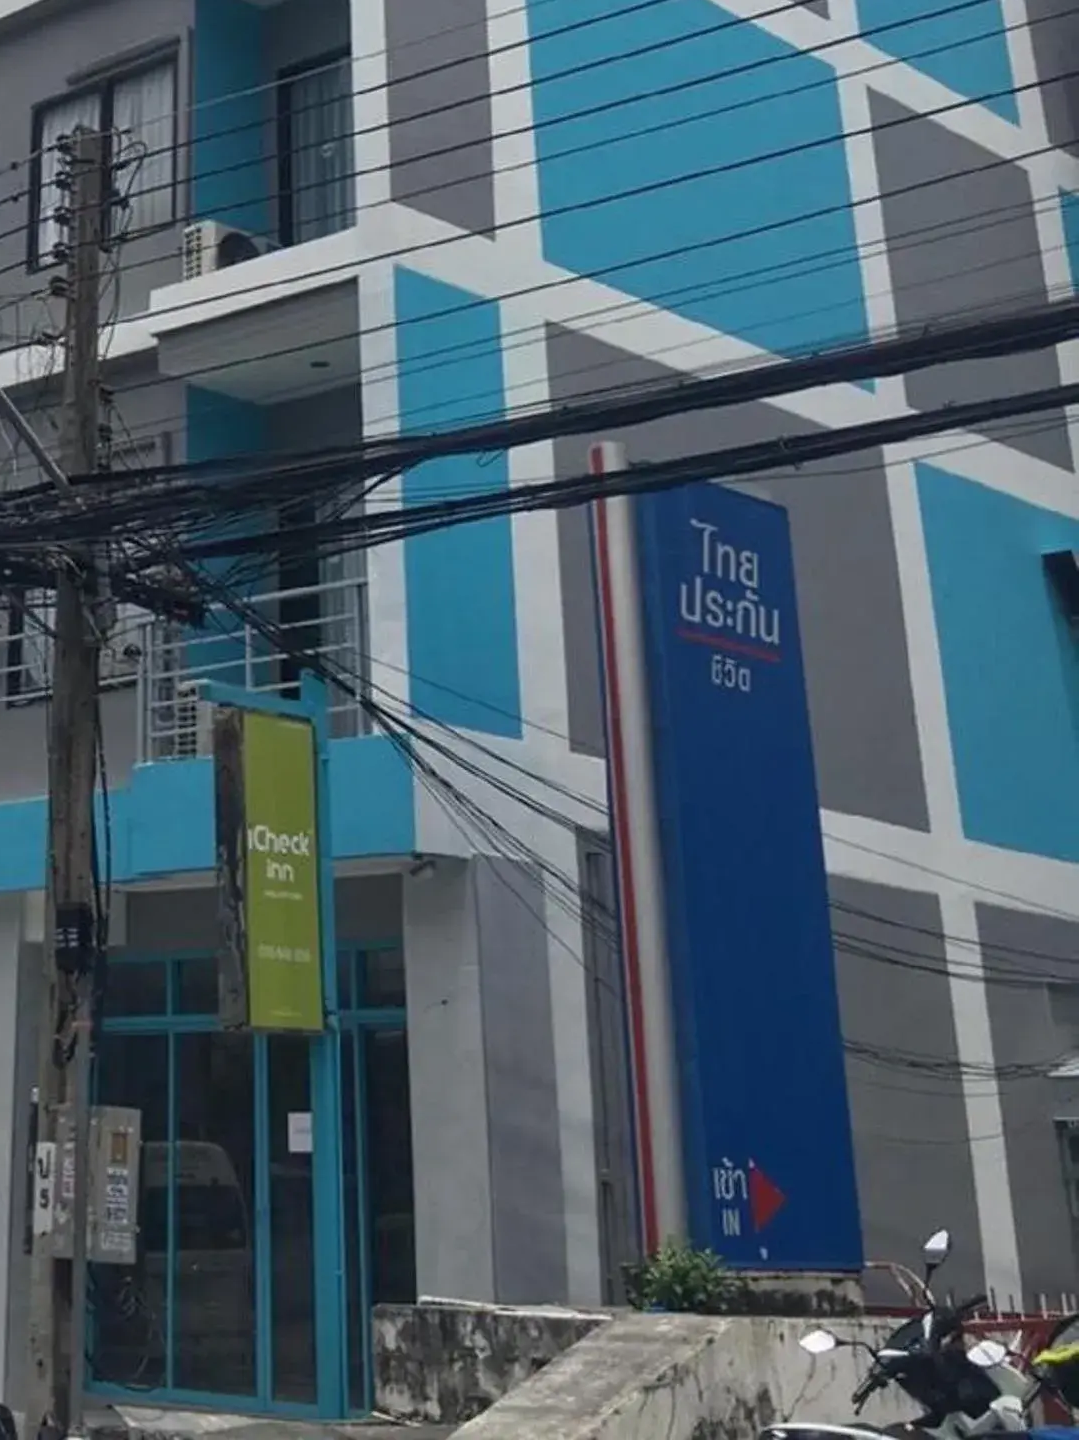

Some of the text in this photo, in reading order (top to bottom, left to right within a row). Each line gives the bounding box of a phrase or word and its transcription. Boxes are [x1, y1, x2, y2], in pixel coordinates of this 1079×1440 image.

[690, 518, 759, 589] ไทย
[680, 576, 780, 645] ประกัน
[248, 825, 310, 856] iCheck
[713, 1157, 747, 1200] เข้า
[723, 1208, 741, 1236] IN
